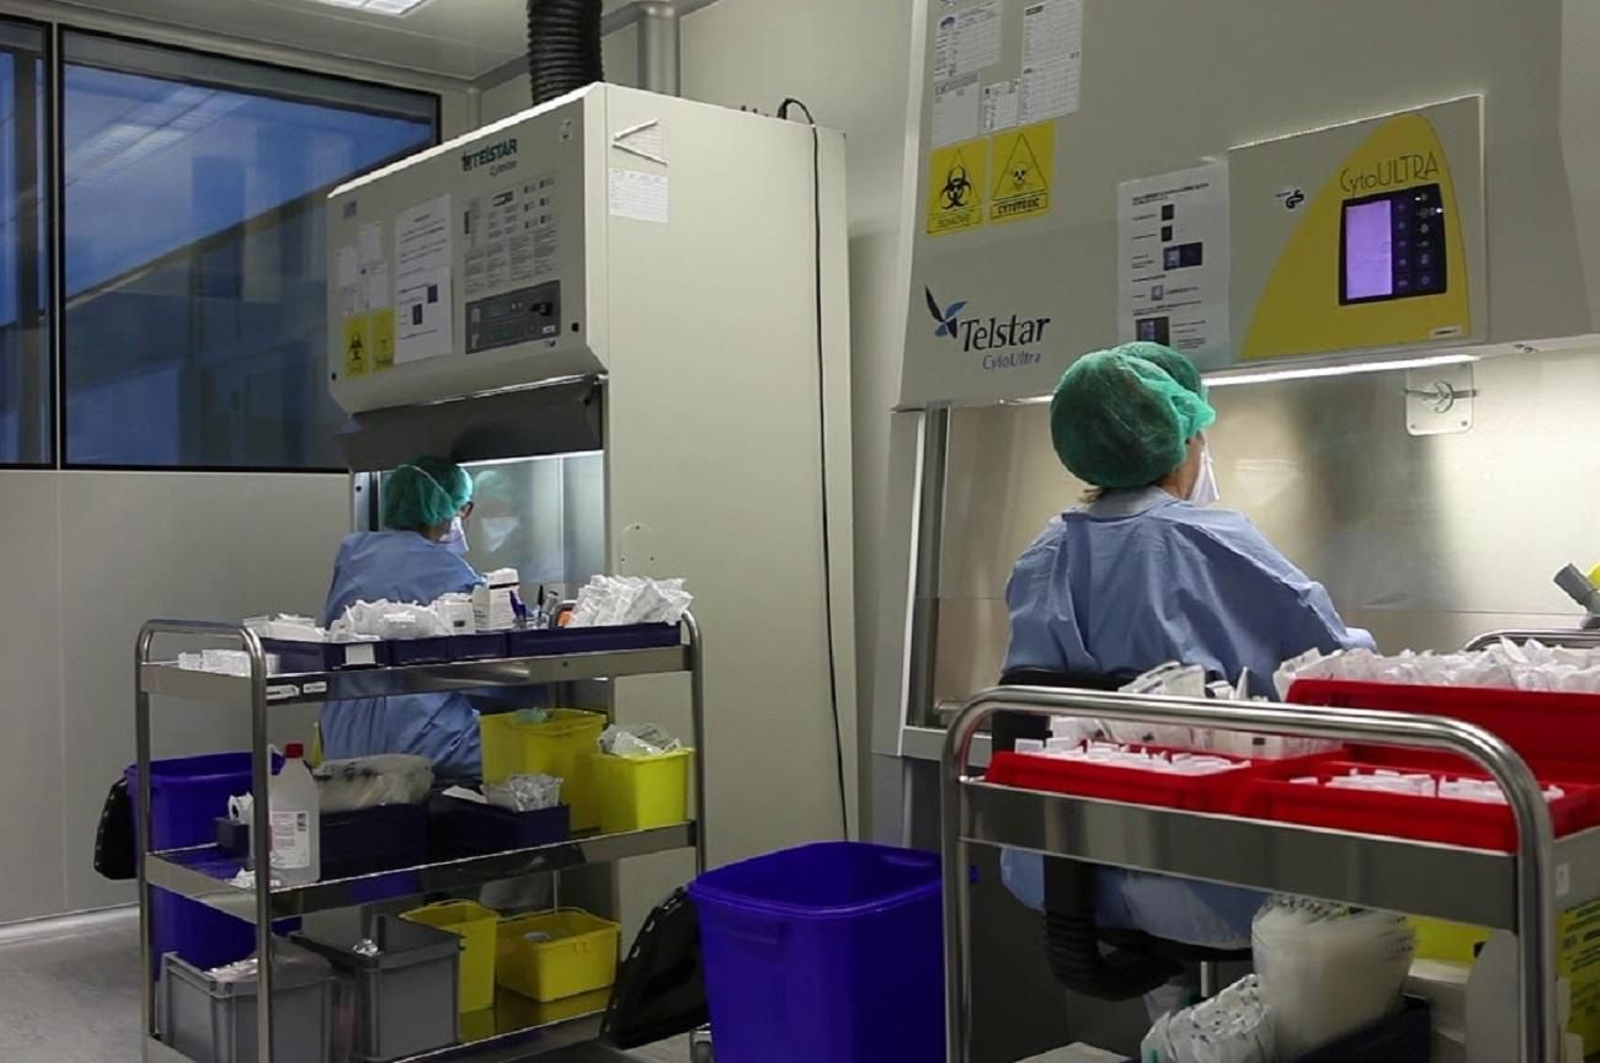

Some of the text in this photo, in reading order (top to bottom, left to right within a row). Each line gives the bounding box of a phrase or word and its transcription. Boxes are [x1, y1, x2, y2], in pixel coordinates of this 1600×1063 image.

[1340, 152, 1439, 196] CytoULTRA
[960, 314, 1051, 351] Telstar
[982, 351, 1042, 373] CytoUltra
